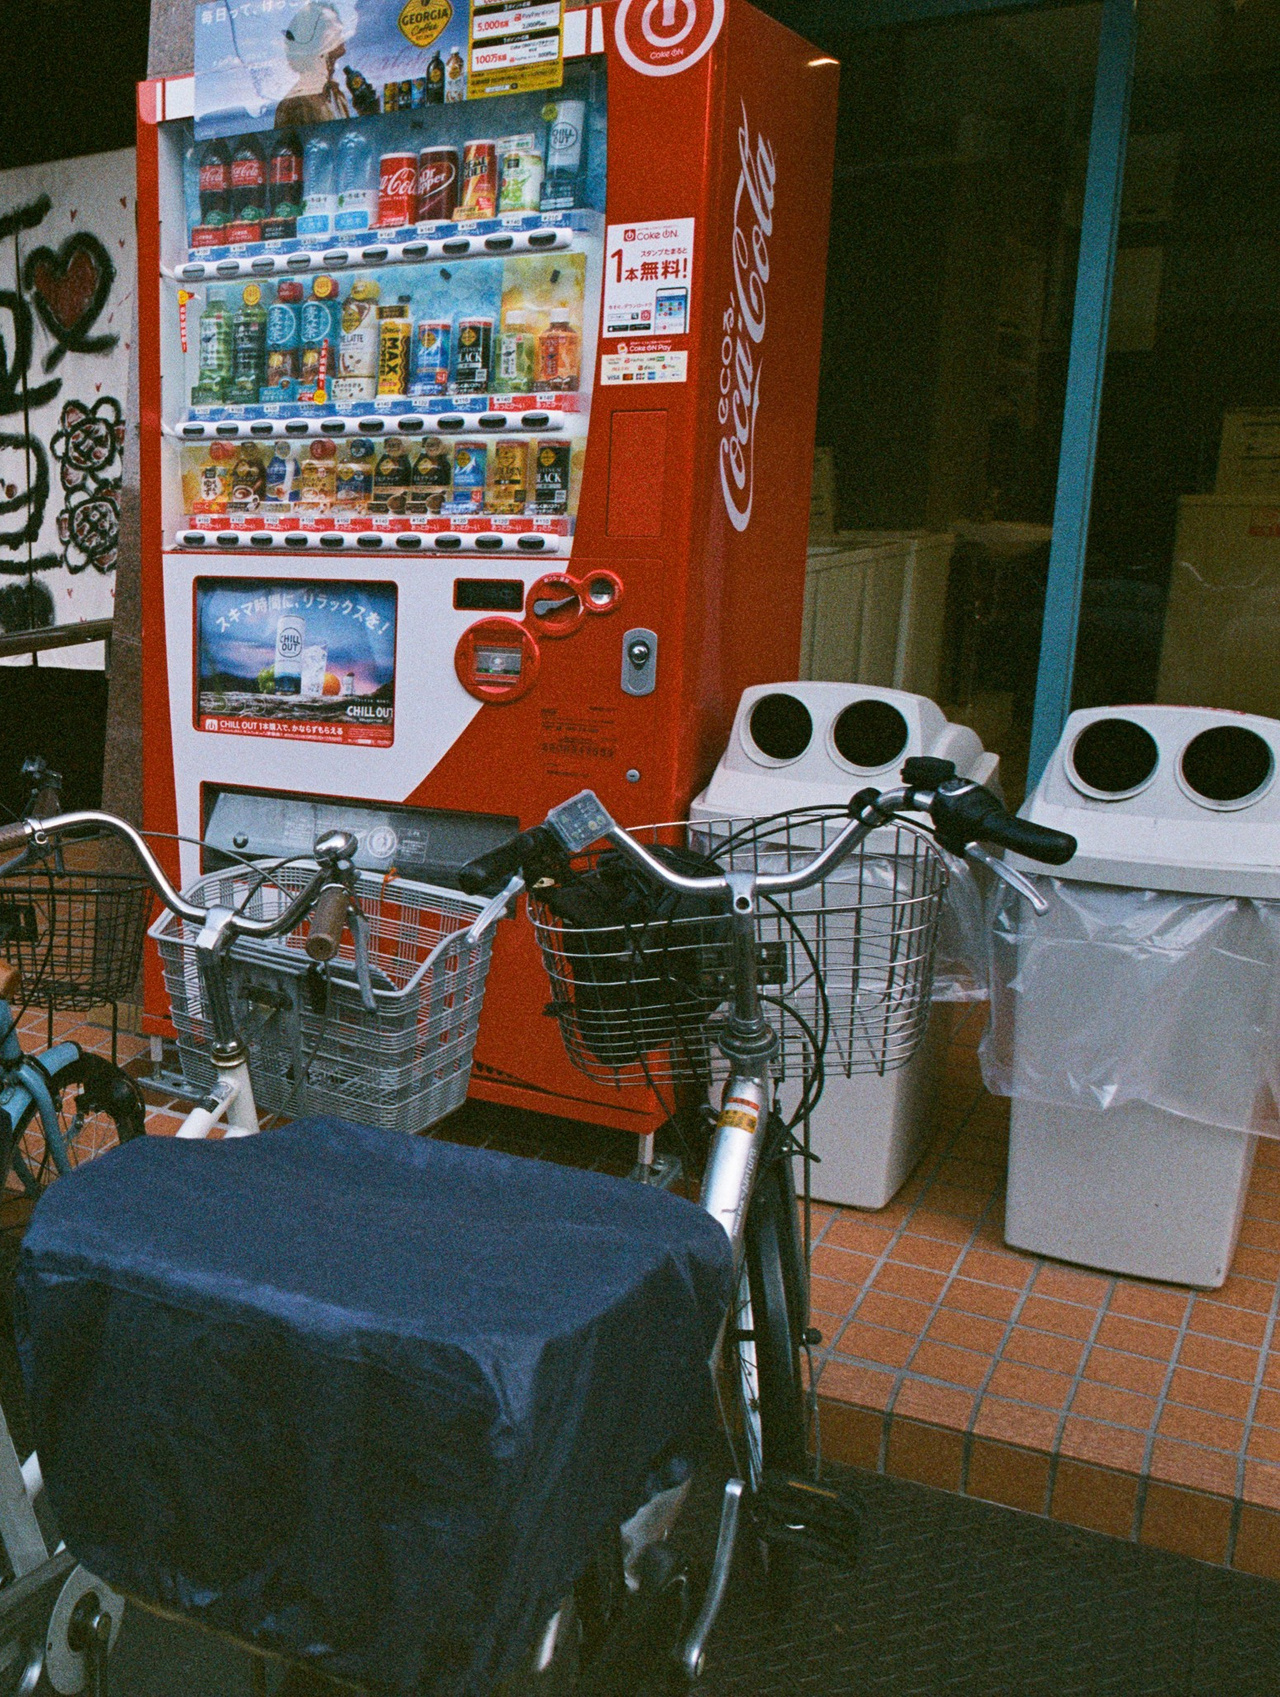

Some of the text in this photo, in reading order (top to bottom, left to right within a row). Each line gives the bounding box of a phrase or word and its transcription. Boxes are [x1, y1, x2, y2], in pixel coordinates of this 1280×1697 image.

[401, 7, 450, 26] GEORGIA
[410, 21, 439, 37] Coffee
[650, 48, 684, 60] Coke ON
[552, 128, 575, 137] CHILL
[557, 135, 571, 145] OUT
[637, 229, 678, 241] Coke ON
[641, 247, 688, 257] スタンプたまると
[720, 94, 777, 533] Coca-Cola
[304, 305, 318, 338] 麦茶
[347, 334, 363, 343] LATTE
[387, 337, 399, 375] MAX
[458, 352, 482, 363] LACK
[536, 472, 561, 483] LACK
[279, 634, 301, 644] CHILL
[281, 643, 298, 652] OUT
[346, 706, 375, 717] CHILL
[220, 720, 241, 728] CHILL
[241, 721, 258, 729] OUT
